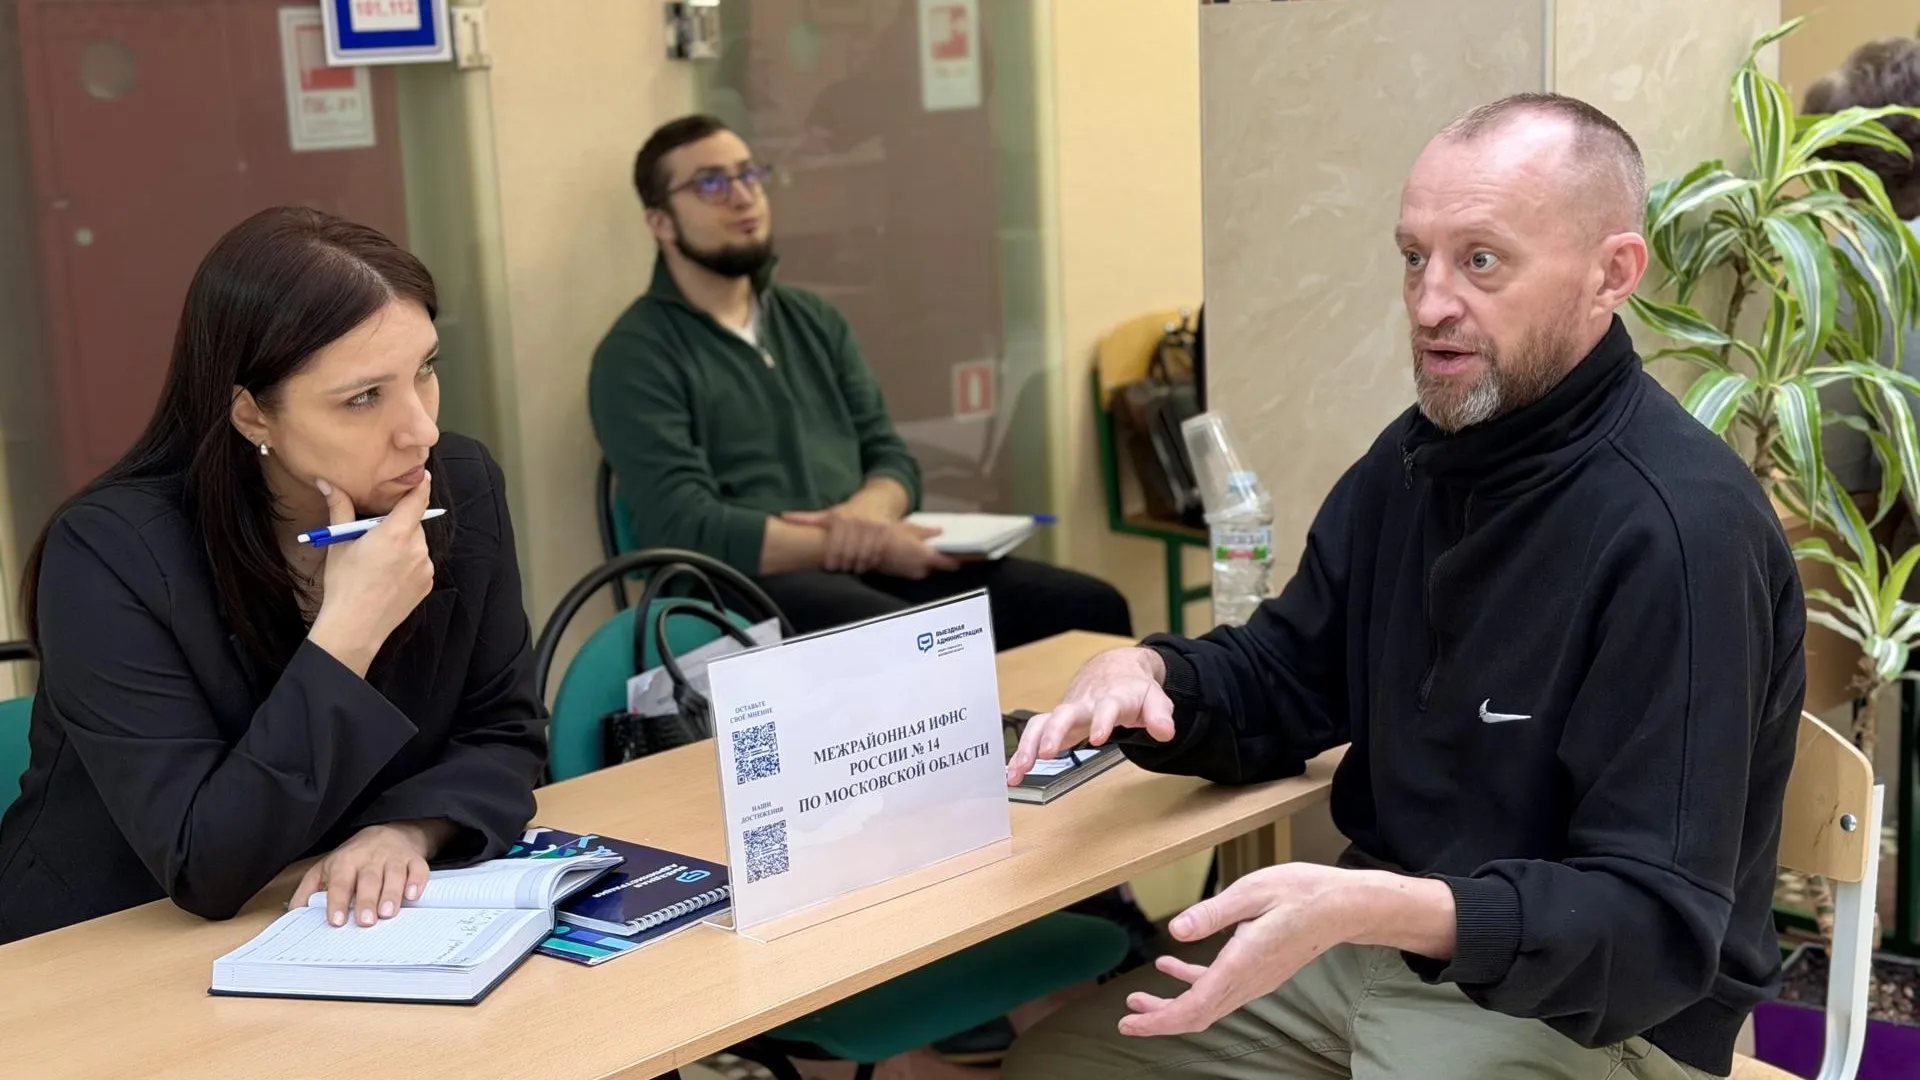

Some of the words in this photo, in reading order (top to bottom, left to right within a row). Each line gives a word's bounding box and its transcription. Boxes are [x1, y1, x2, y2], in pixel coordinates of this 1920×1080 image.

[936, 624, 965, 636] ВЫЕЗДНАЯ
[937, 627, 983, 645] АДМИНИСТРАЦИЯ
[735, 701, 766, 713] ОСТАВЬТЕ
[747, 707, 773, 718] МНЕНИЕ
[813, 720, 926, 765] МЕЖРАЙОННАЯ
[928, 707, 968, 731] ИФНС
[850, 747, 909, 776] РОССИИ
[911, 742, 925, 758] №
[928, 737, 941, 752] 14
[799, 795, 822, 813] ПО
[825, 760, 926, 805] МОСКОВСКОЙ
[929, 742, 991, 772] ОБЛАСТИ
[741, 806, 784, 824] ДОСТИЖЕНИЯ
[752, 801, 772, 812] НАШИ
